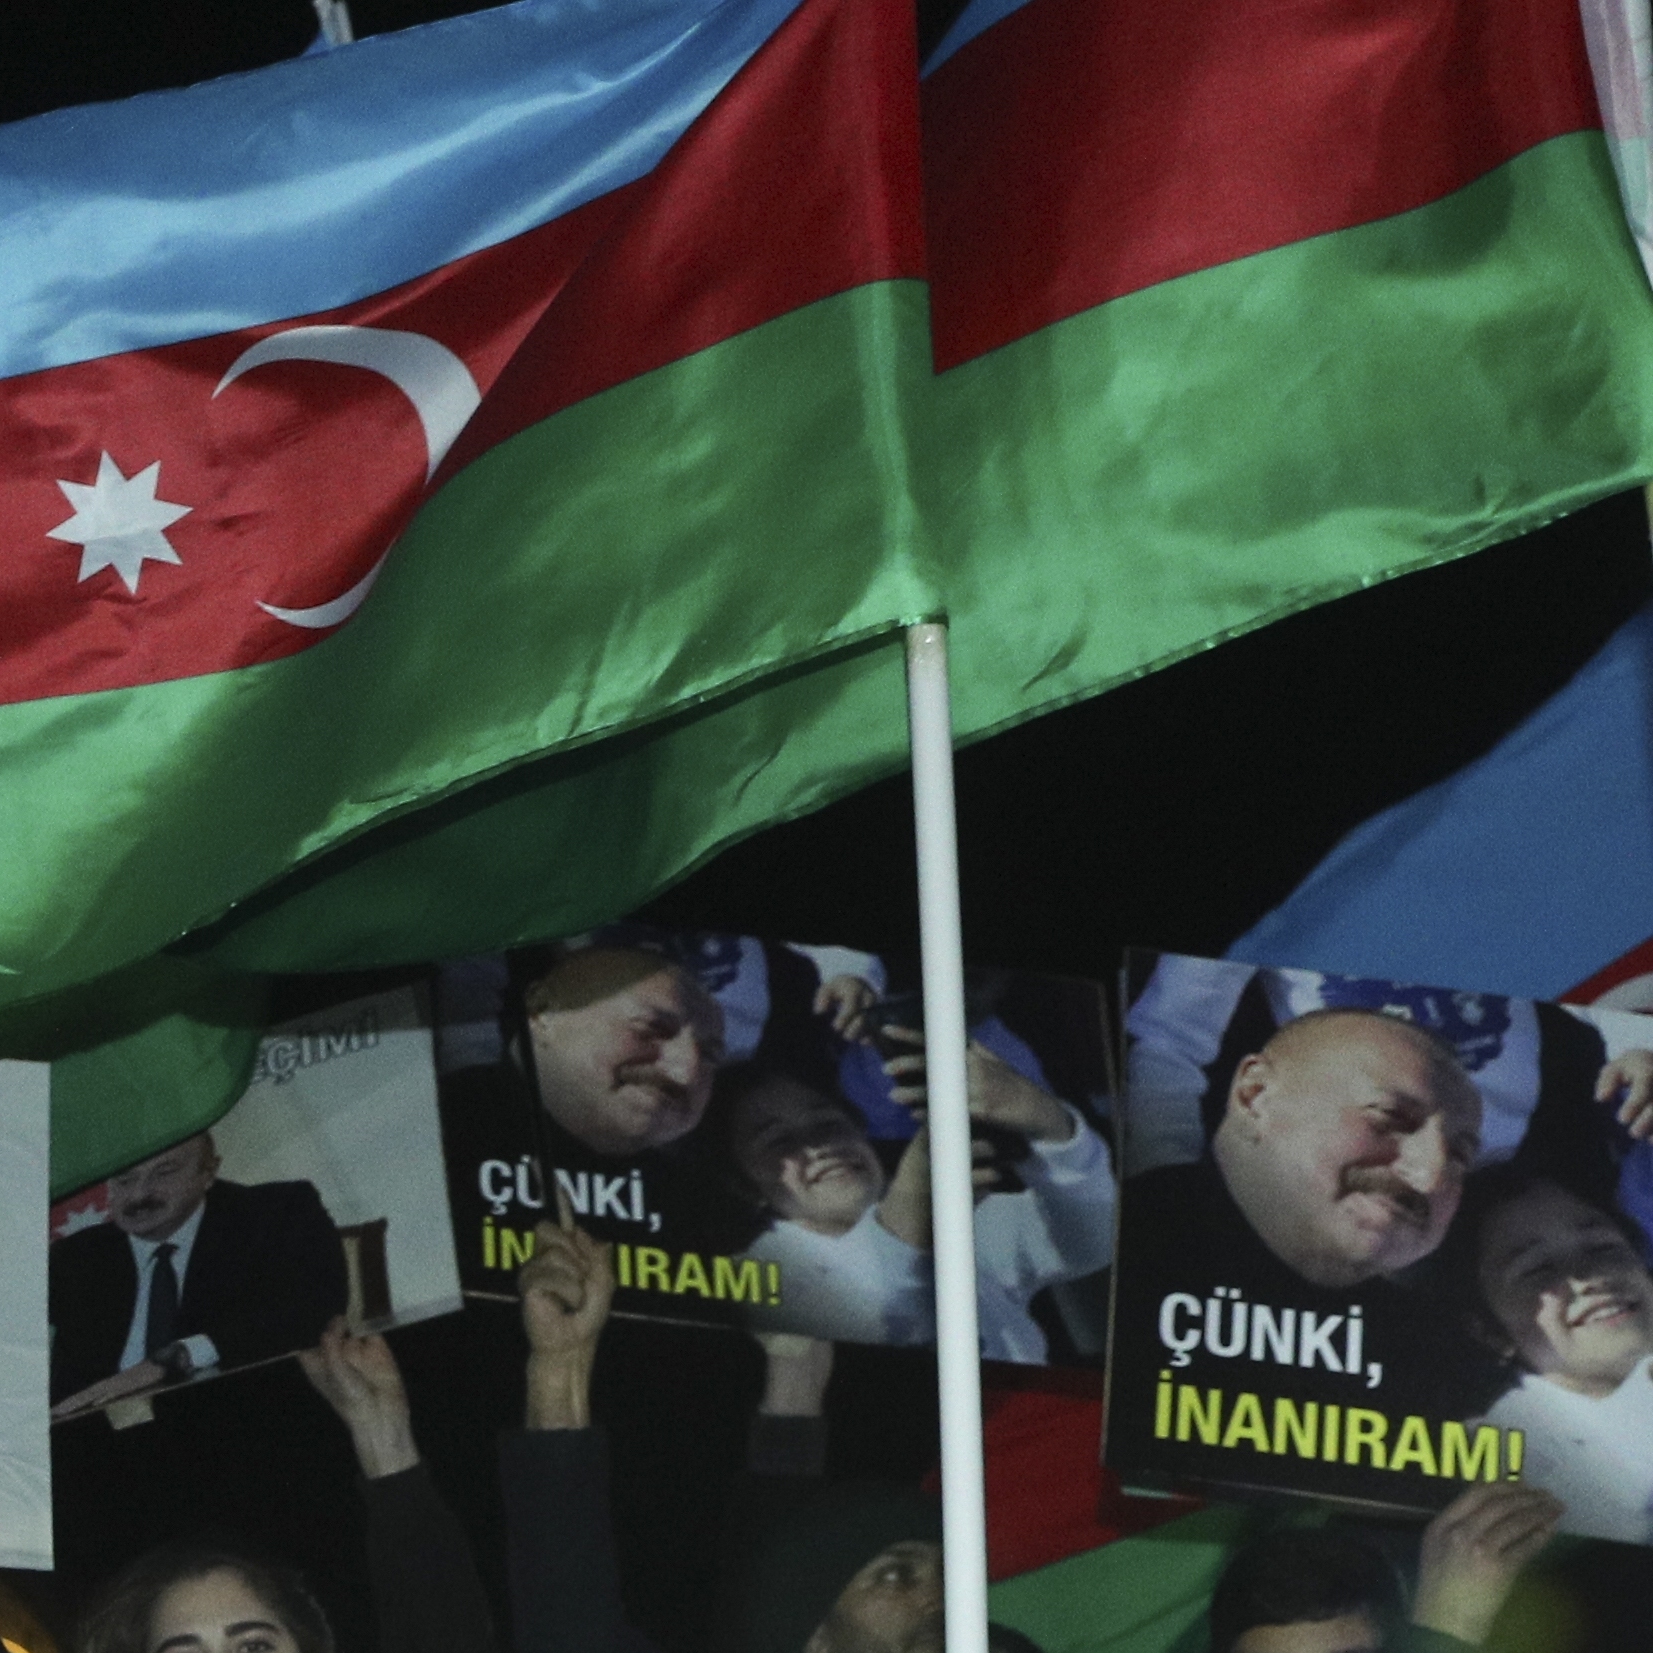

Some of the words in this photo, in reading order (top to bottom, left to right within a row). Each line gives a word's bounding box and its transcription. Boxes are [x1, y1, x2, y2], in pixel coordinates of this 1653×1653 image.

[481, 1215, 782, 1307] İNIRAM!
[1157, 1286, 1384, 1388] ÇÜNKİ,
[1154, 1370, 1525, 1483] İNANIRAM!
